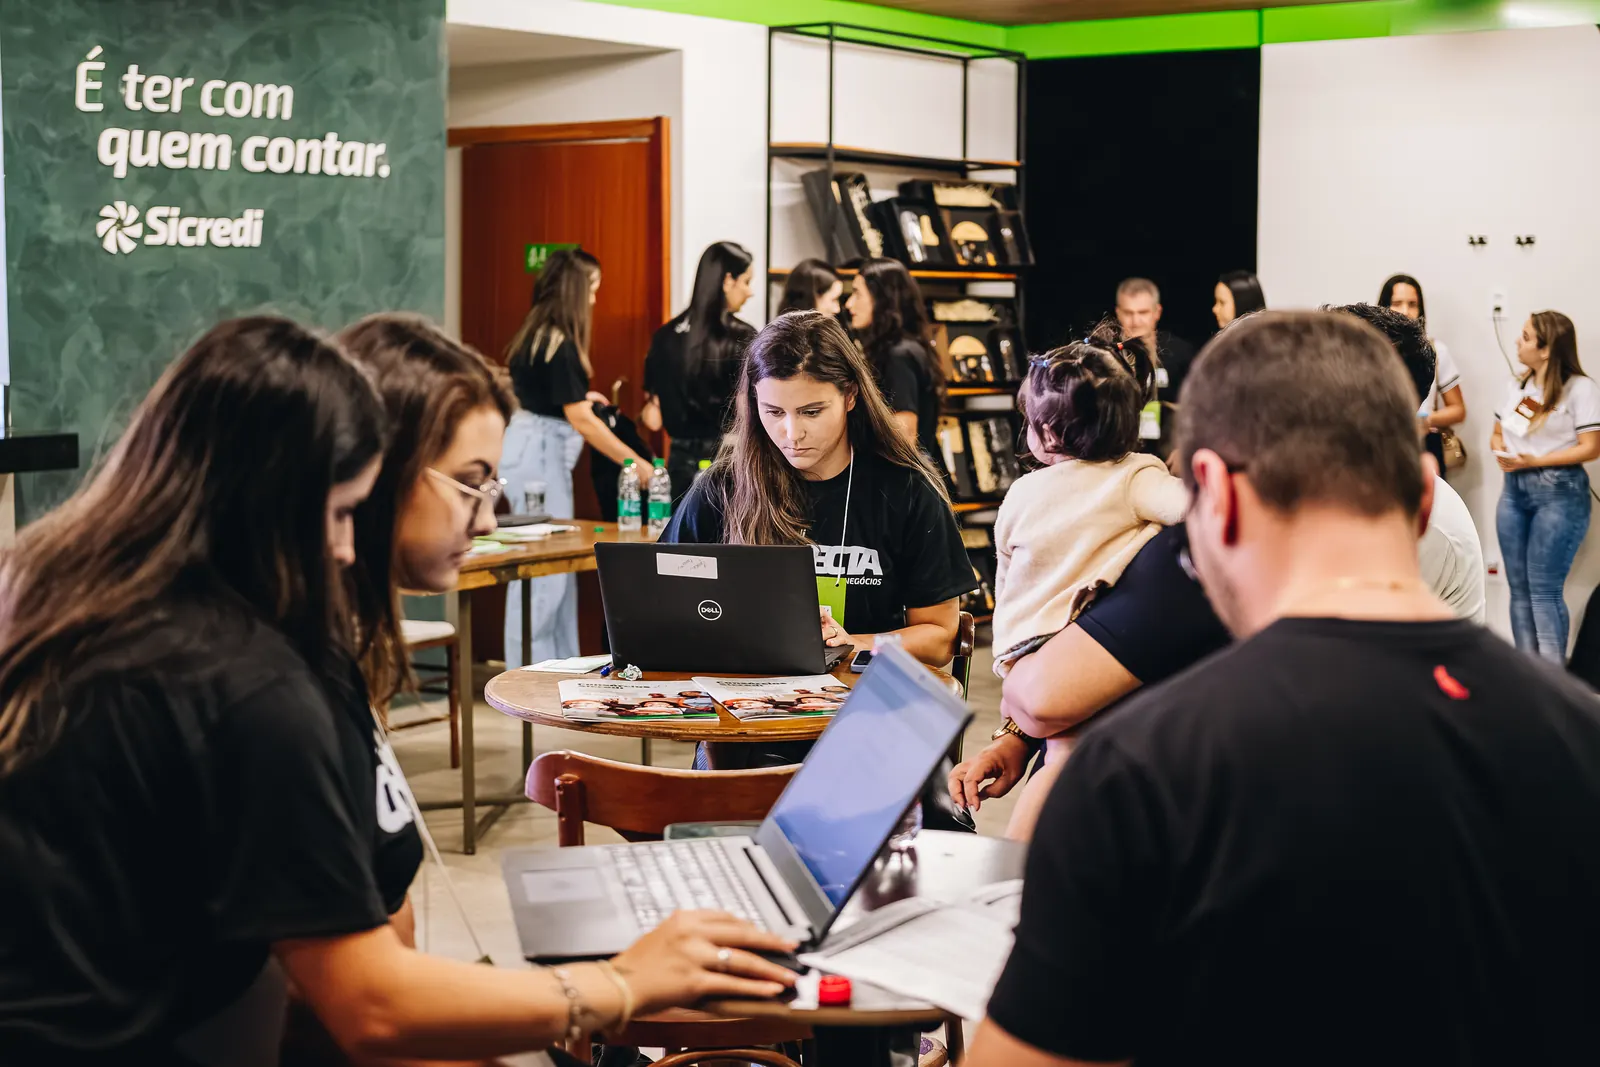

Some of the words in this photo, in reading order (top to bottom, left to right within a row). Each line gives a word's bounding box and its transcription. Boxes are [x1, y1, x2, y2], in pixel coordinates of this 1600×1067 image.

[75, 45, 106, 112] É
[121, 64, 195, 113] ter
[199, 79, 294, 120] com
[97, 127, 233, 179] quem
[240, 132, 391, 178] contar.
[144, 206, 264, 247] Sicredi
